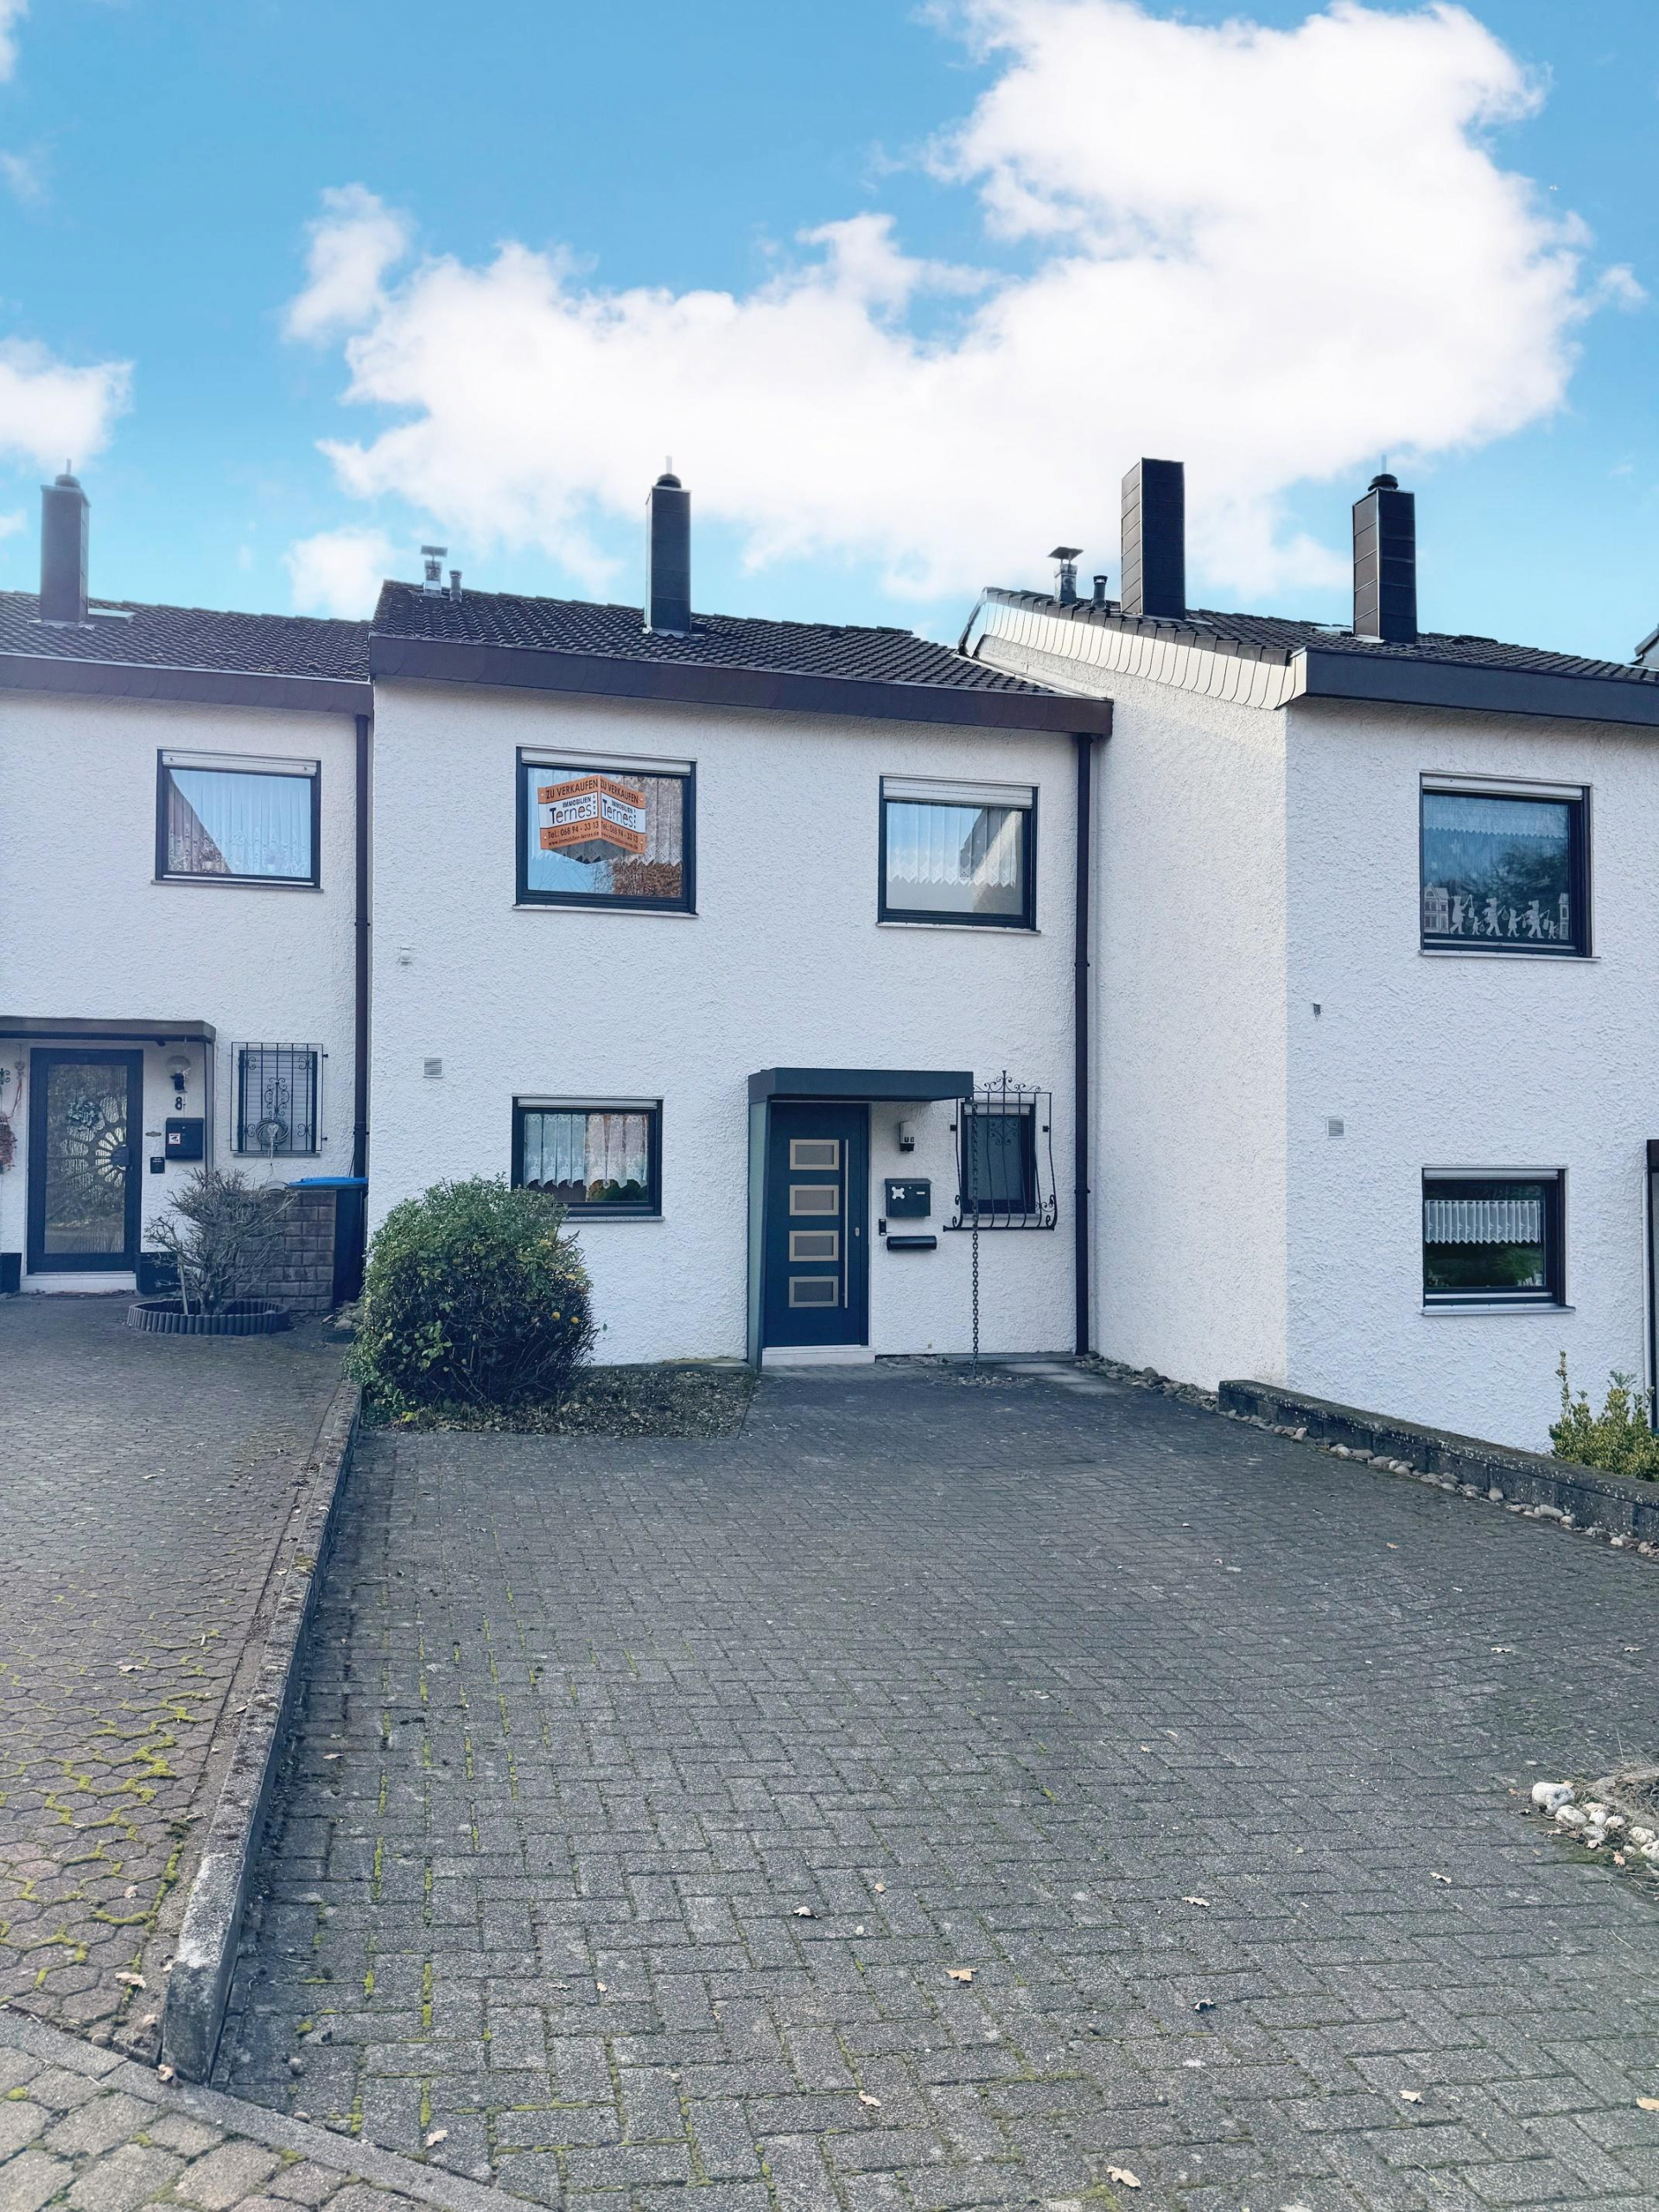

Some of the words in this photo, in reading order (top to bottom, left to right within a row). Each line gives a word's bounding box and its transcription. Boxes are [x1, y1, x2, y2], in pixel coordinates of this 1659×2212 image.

[546, 789, 555, 799] ZU
[556, 779, 598, 797] VERKAUFEN
[600, 779, 607, 789] ZU
[607, 782, 639, 804] VERKAUFEN
[563, 796, 592, 808] IMMOBILIEN
[611, 799, 633, 814] IMMOBILIEN
[549, 804, 592, 824] Ternes
[601, 798, 633, 828] Ternes
[560, 828, 570, 836] 068
[571, 825, 578, 834] 94
[584, 823, 590, 831] 33
[593, 820, 599, 829] 13
[175, 1096, 183, 1110] 8
